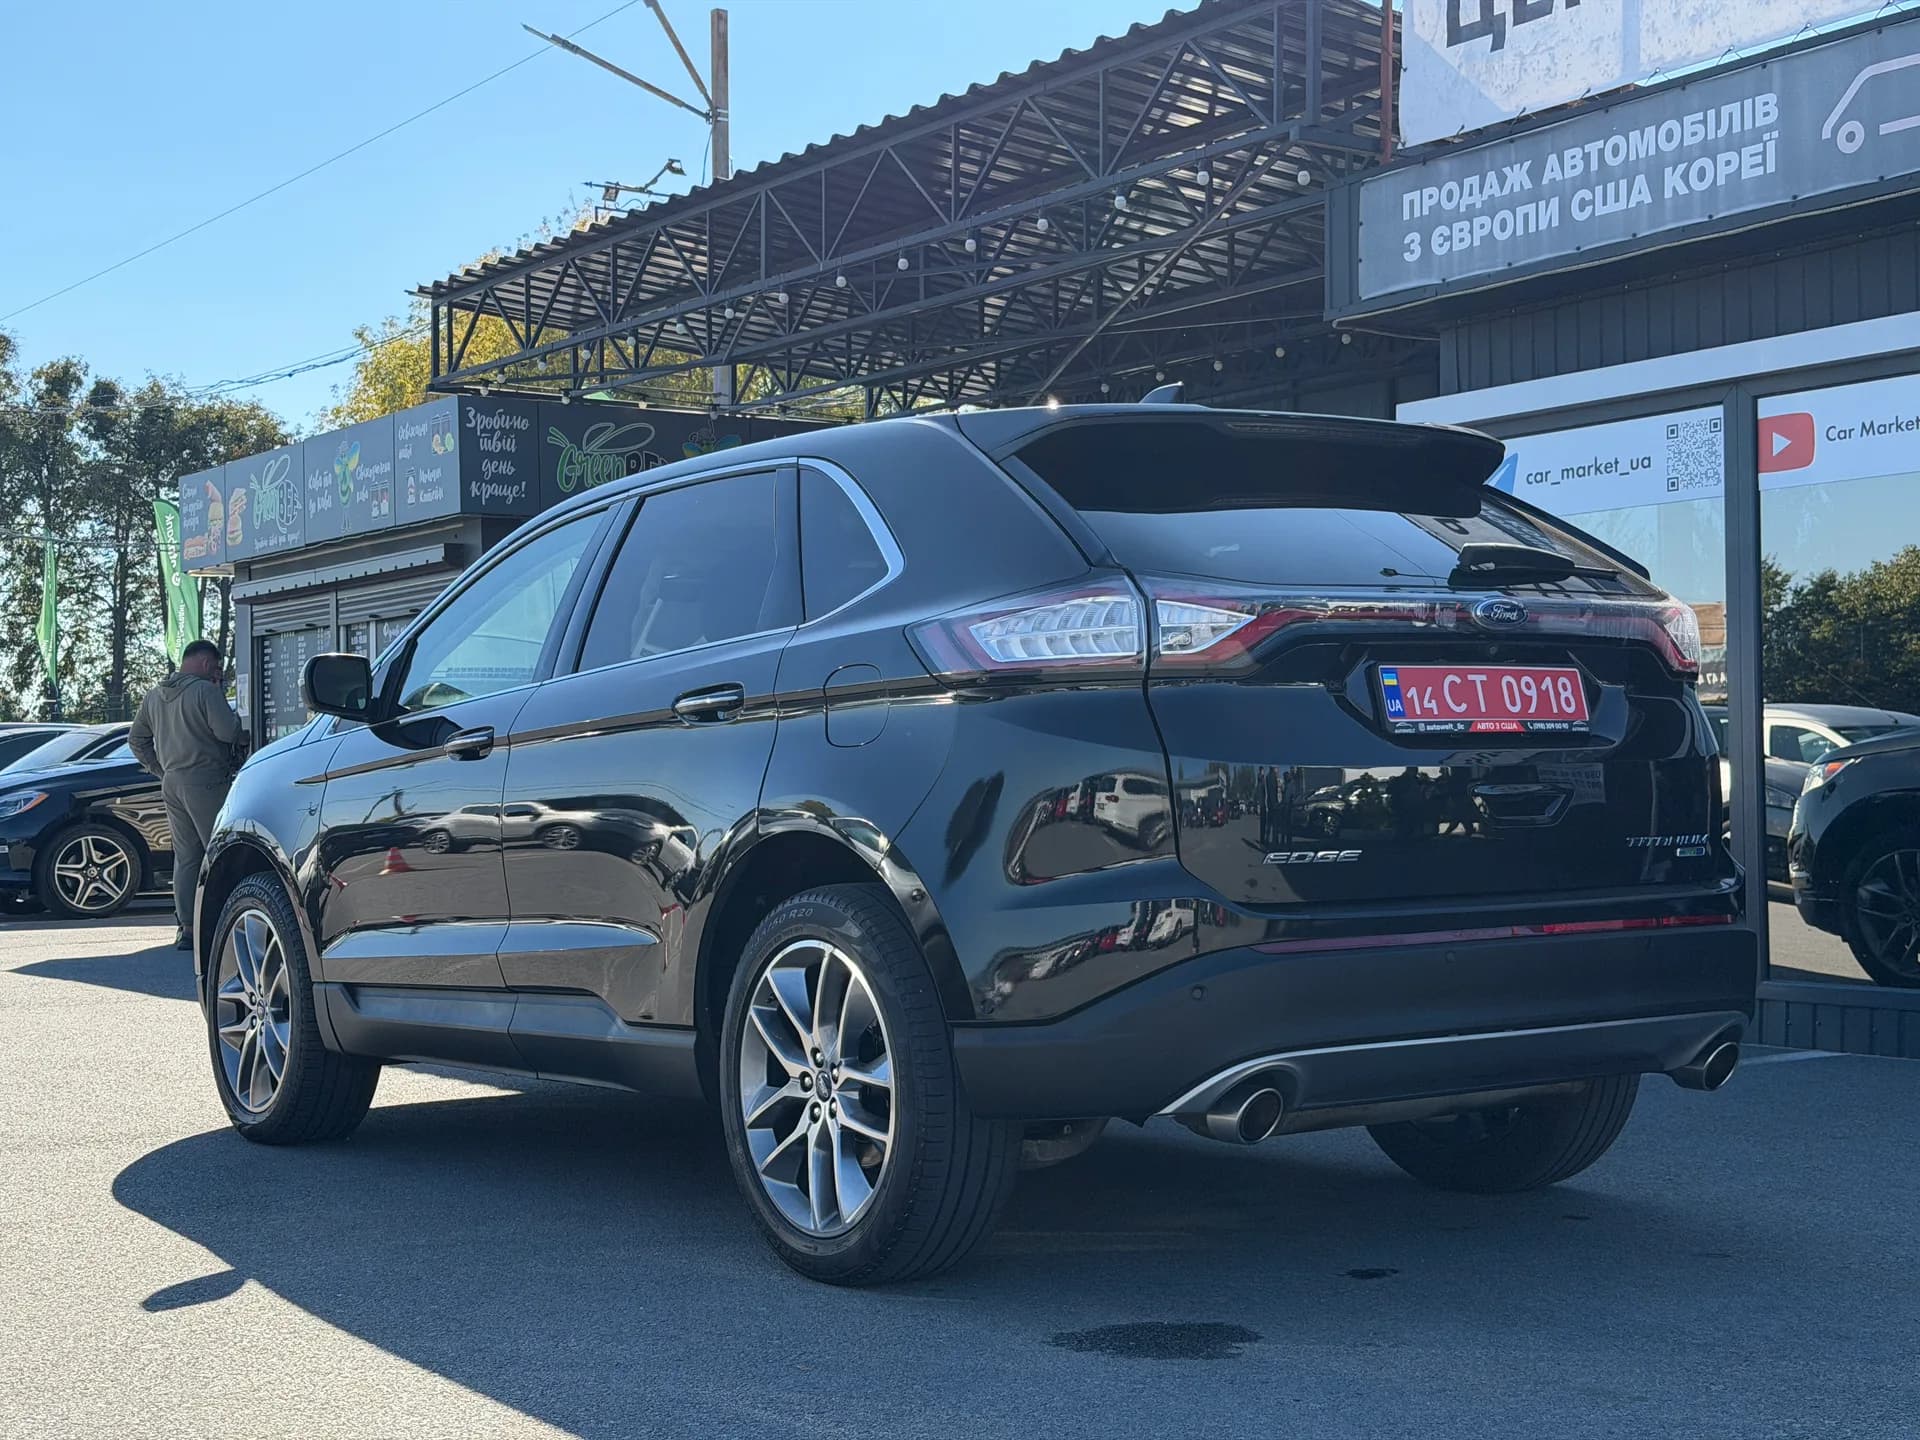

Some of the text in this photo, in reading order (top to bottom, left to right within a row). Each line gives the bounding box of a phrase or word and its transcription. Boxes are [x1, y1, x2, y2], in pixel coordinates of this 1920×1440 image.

[1402, 92, 1779, 221] ПРОДАЖ АВТОМОБІЛІВ
[1403, 130, 1779, 262] З ЄВРОПИ США КОРЕЇ
[466, 406, 530, 436] Зробимо
[1826, 415, 1920, 442] Car Market
[480, 430, 517, 453] твій
[481, 459, 516, 480] день
[1526, 455, 1651, 486] car_market_ua
[470, 481, 527, 506] краще!
[1490, 603, 1518, 620] Ford
[1387, 699, 1403, 712] UA
[1406, 686, 1439, 715] 14
[1501, 675, 1576, 714] 0918
[1263, 849, 1363, 865] EDGE
